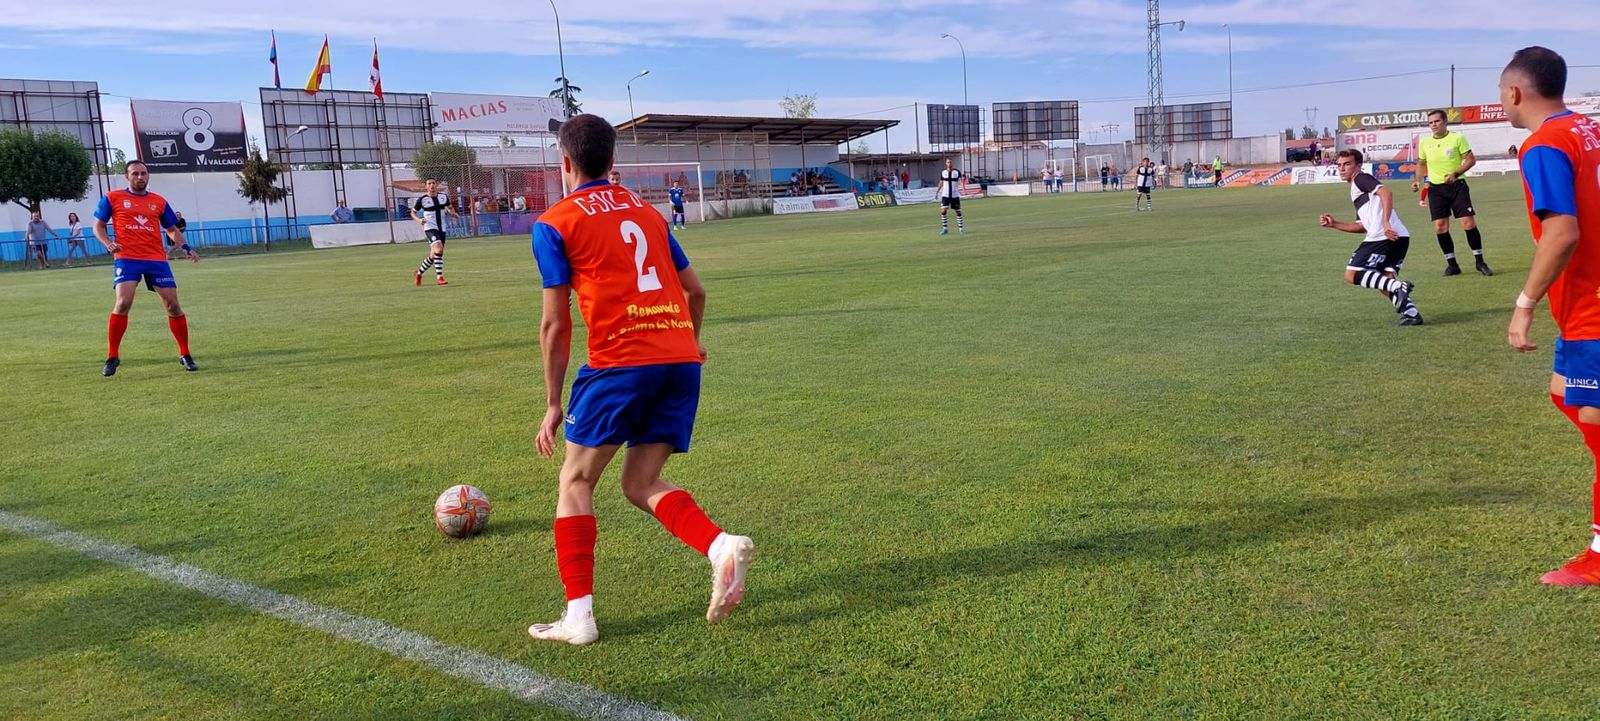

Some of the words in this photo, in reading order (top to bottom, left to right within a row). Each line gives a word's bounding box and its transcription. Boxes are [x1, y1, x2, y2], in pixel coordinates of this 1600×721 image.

[442, 100, 507, 122] MACIAS
[1393, 111, 1430, 124] RURA
[182, 107, 215, 151] 8
[620, 220, 663, 293] 2
